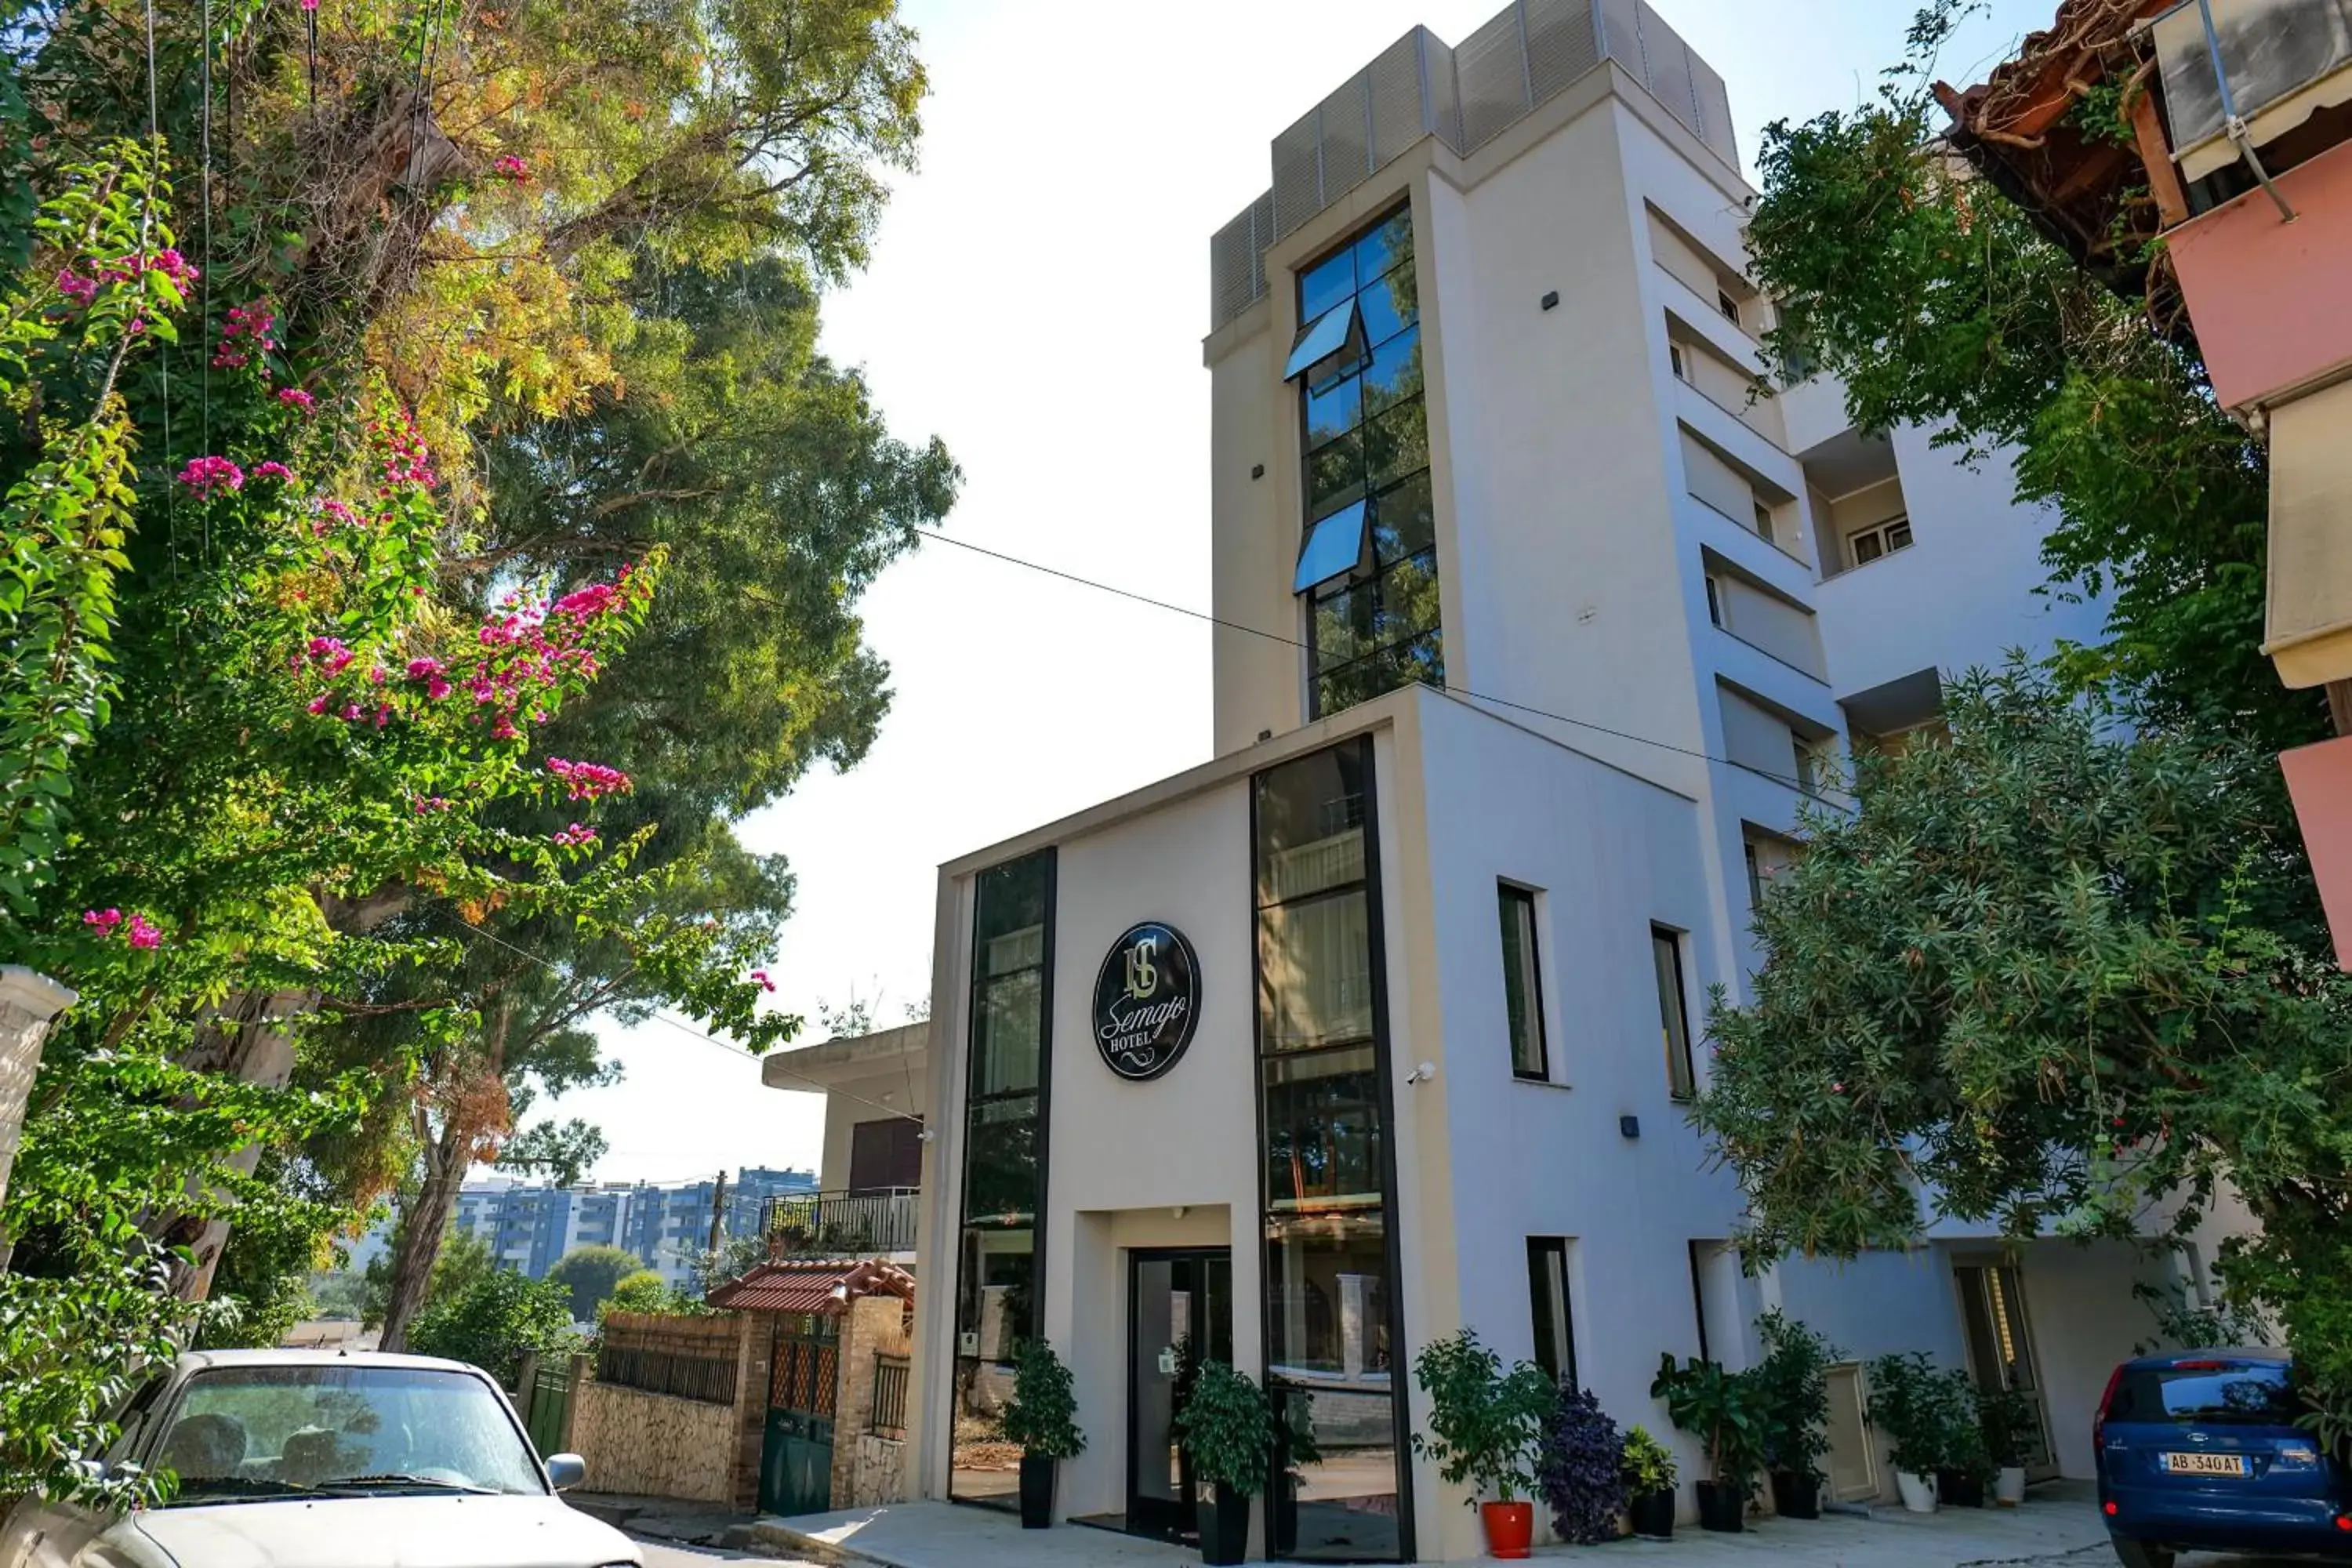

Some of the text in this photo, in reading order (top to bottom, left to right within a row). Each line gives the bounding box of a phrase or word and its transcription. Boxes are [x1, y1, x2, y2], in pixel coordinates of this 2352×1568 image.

[1101, 994, 1186, 1039] Semajo
[1110, 1031, 1152, 1053] HOTEL
[2172, 1454, 2188, 1468] AB
[2224, 1457, 2240, 1472] AT
